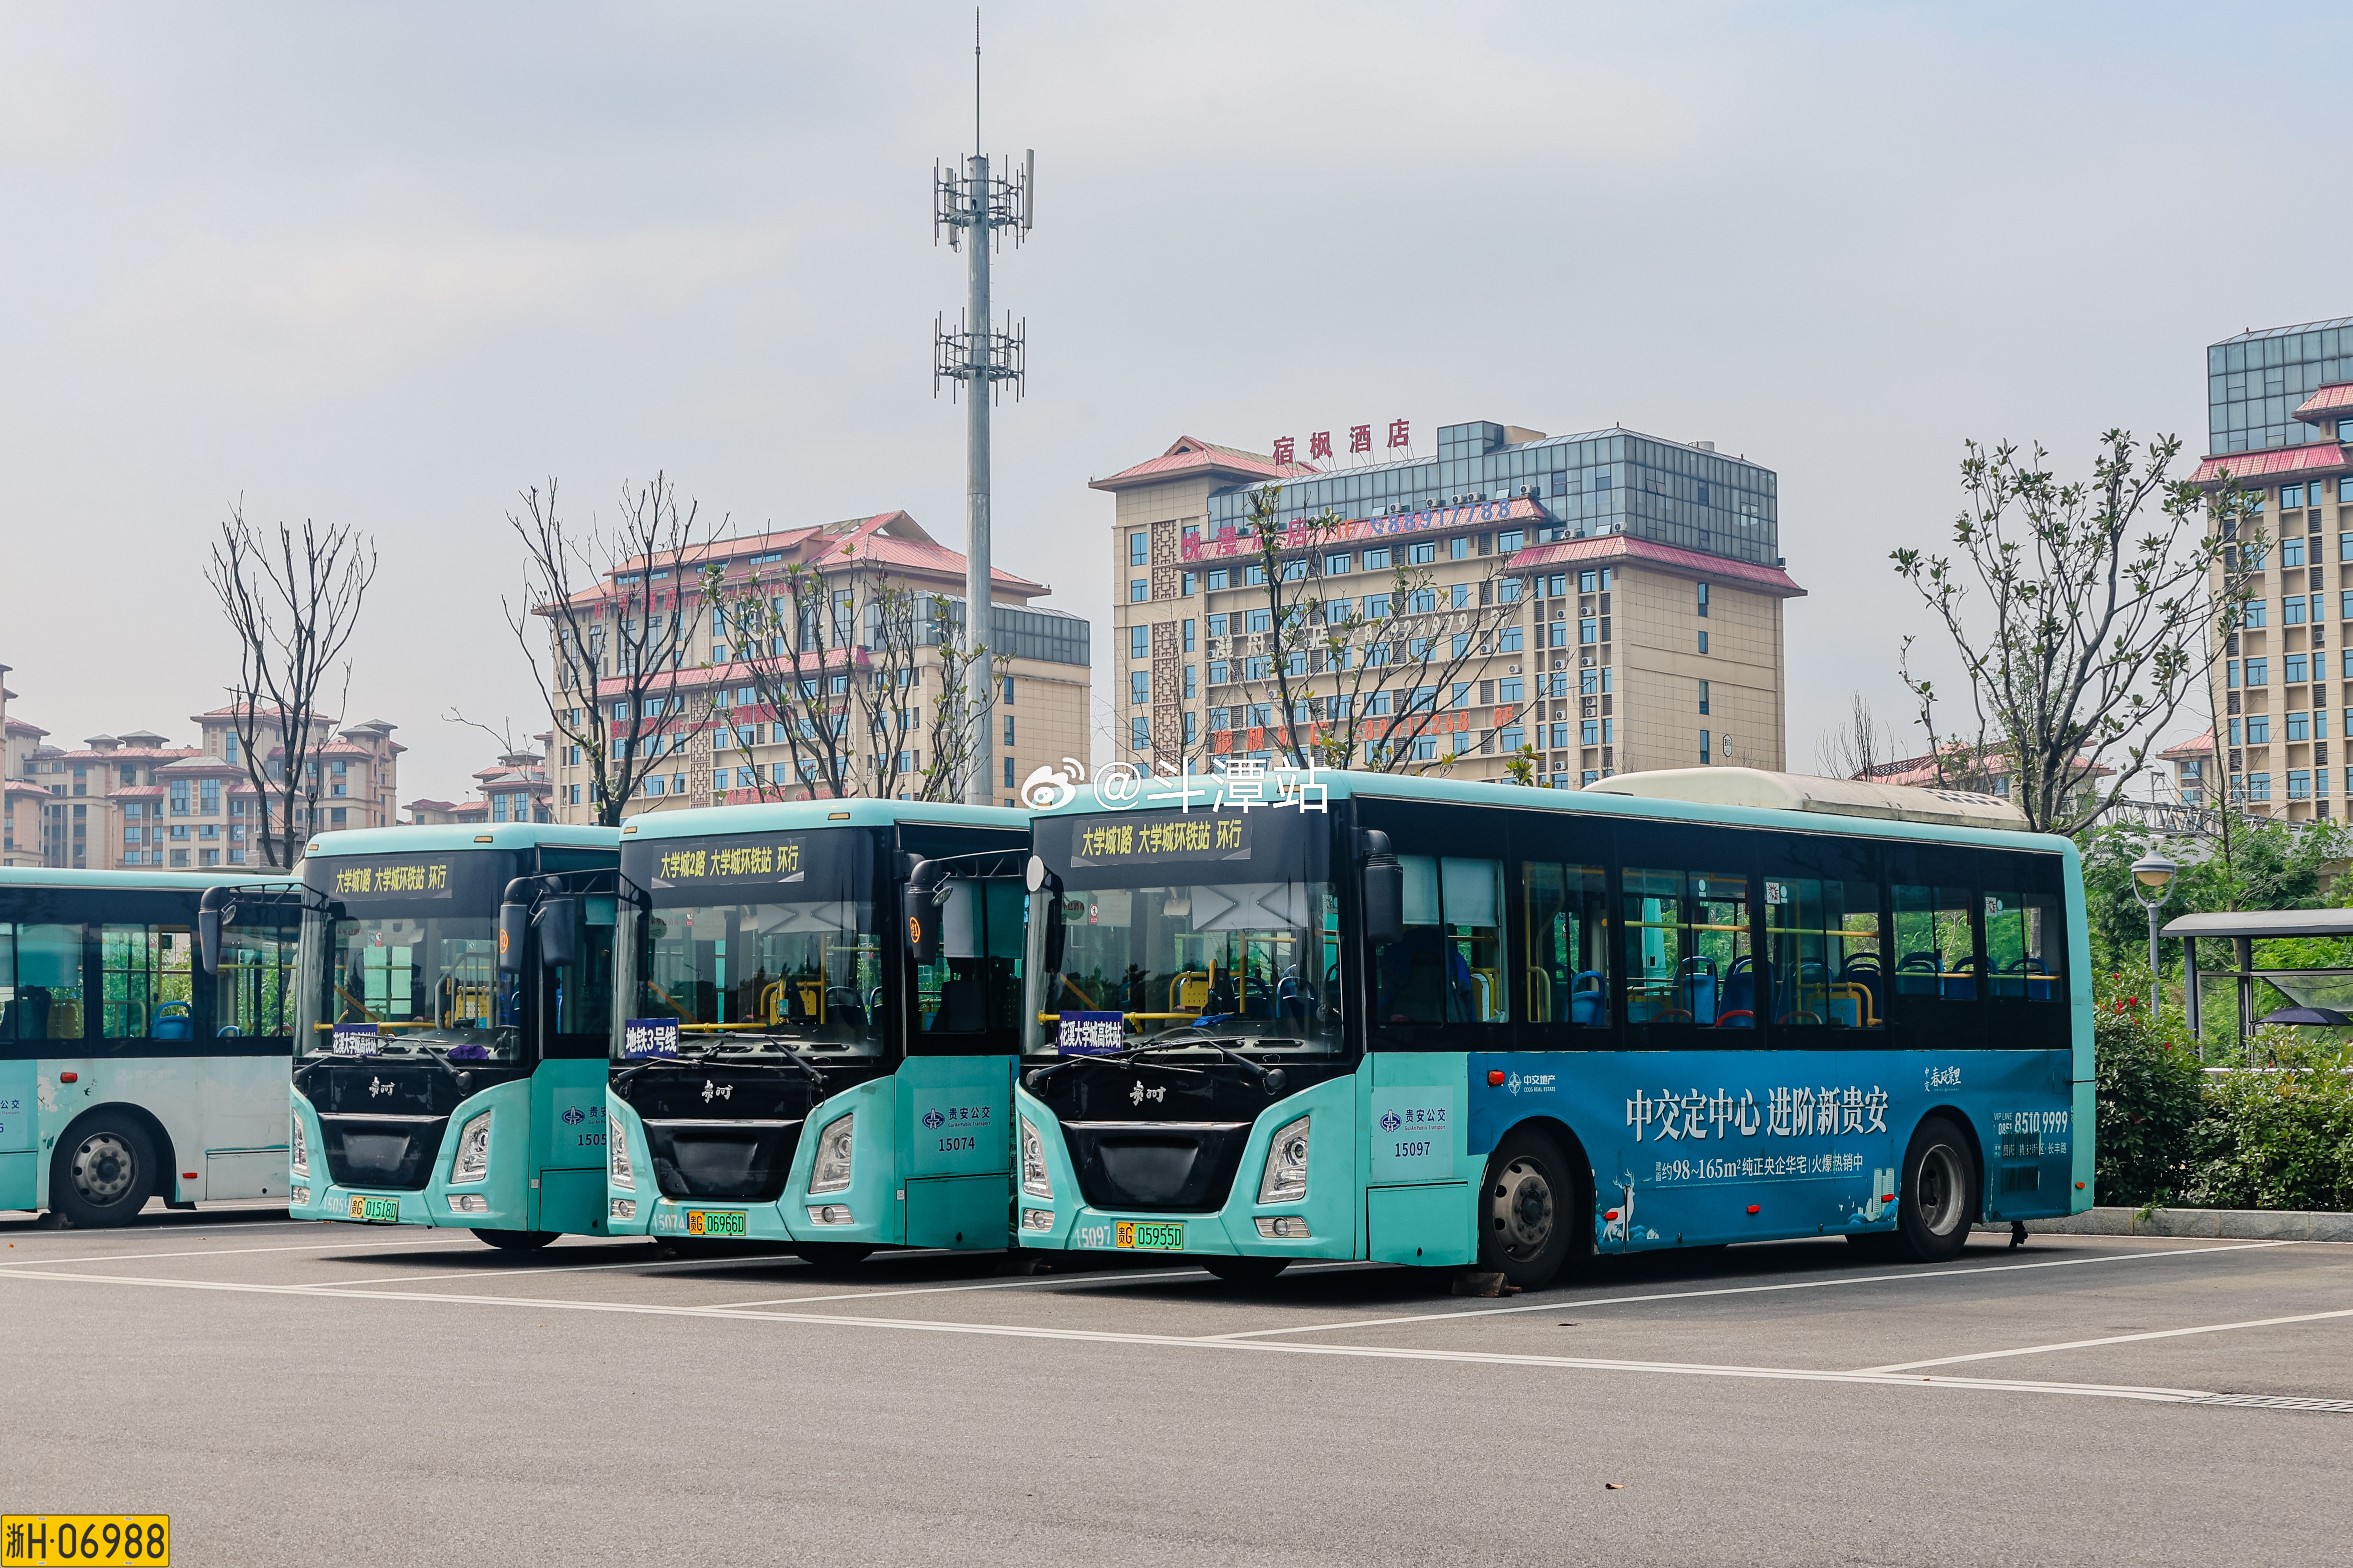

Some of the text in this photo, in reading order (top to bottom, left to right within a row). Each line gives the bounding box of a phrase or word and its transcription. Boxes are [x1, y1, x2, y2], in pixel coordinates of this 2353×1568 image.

[1273, 419, 1409, 465] 宿枫酒店
[1182, 516, 1307, 561] 悦漫店
[1388, 499, 1510, 532] 88917788
[1081, 819, 1243, 856] 大学城1路 大学城环铁站 环行
[660, 845, 799, 879] 大学城2路 大学城环铁站 环行
[335, 864, 447, 893] 大学城1路 大学城环铁站 环行
[332, 1031, 376, 1054] 花溪大学城高铁站
[625, 1026, 677, 1053] 地铁3号线
[1060, 1020, 1122, 1048] 花溪大学城高铁站
[1523, 1075, 1556, 1085] 中交地产
[948, 1106, 991, 1121] 贵安公交
[1406, 1107, 1446, 1123] 贵安公交
[1626, 1085, 1888, 1142] 中交定中心 进阶新贵安
[1994, 1112, 2012, 1121] VIP LINE
[2015, 1111, 2040, 1134] 8510
[2042, 1110, 2068, 1134] 9999
[939, 1137, 975, 1152] 15074
[1395, 1141, 1430, 1157] 15097
[1075, 1225, 1111, 1247] 15097
